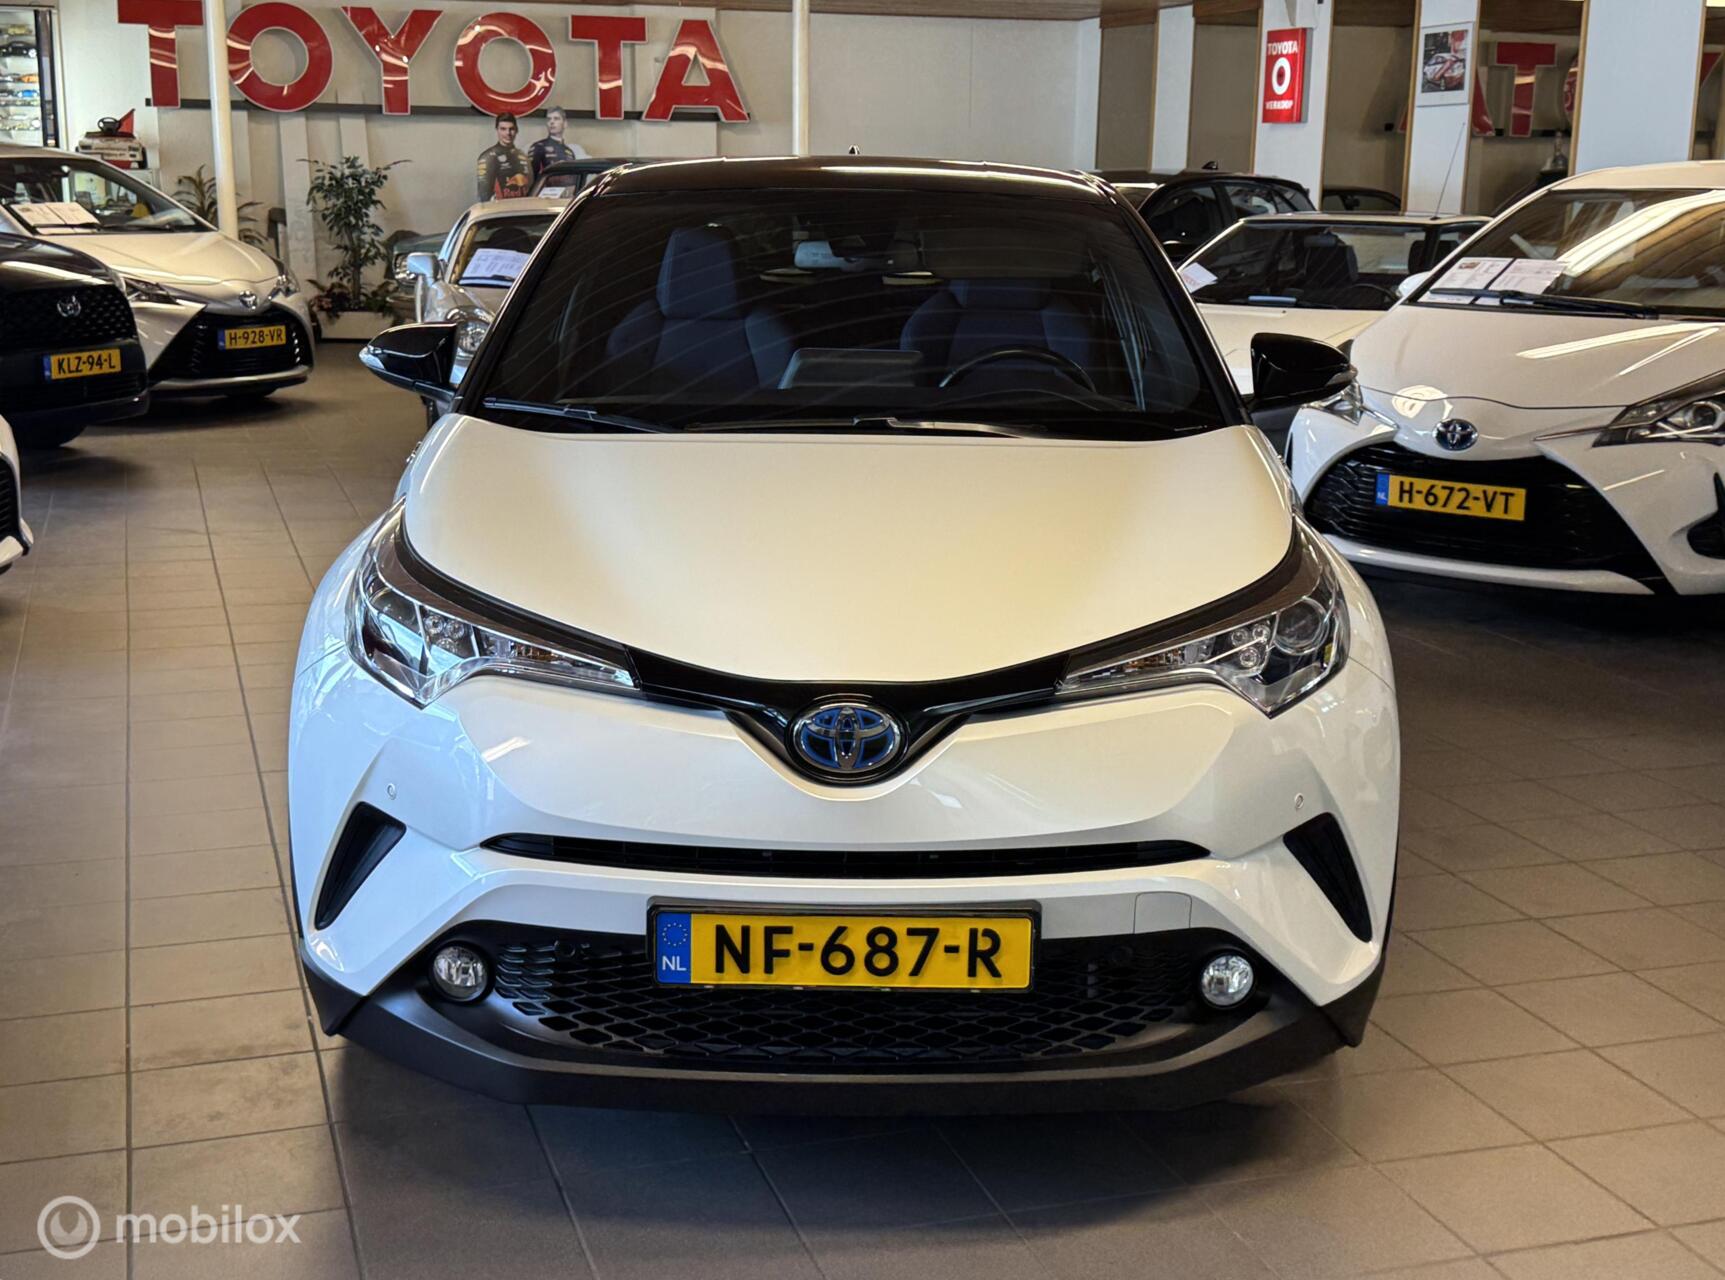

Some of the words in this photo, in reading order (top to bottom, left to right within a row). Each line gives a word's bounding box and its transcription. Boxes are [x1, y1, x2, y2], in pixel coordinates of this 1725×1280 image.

[117, 0, 750, 122] TOYOTA
[1267, 40, 1299, 55] TOYOTA
[228, 328, 284, 346] H-928-VR
[57, 353, 116, 375] KLZ-94-L
[1399, 480, 1515, 515] H-672-VT
[662, 955, 687, 971] NL
[715, 924, 1002, 979] NF-687-R
